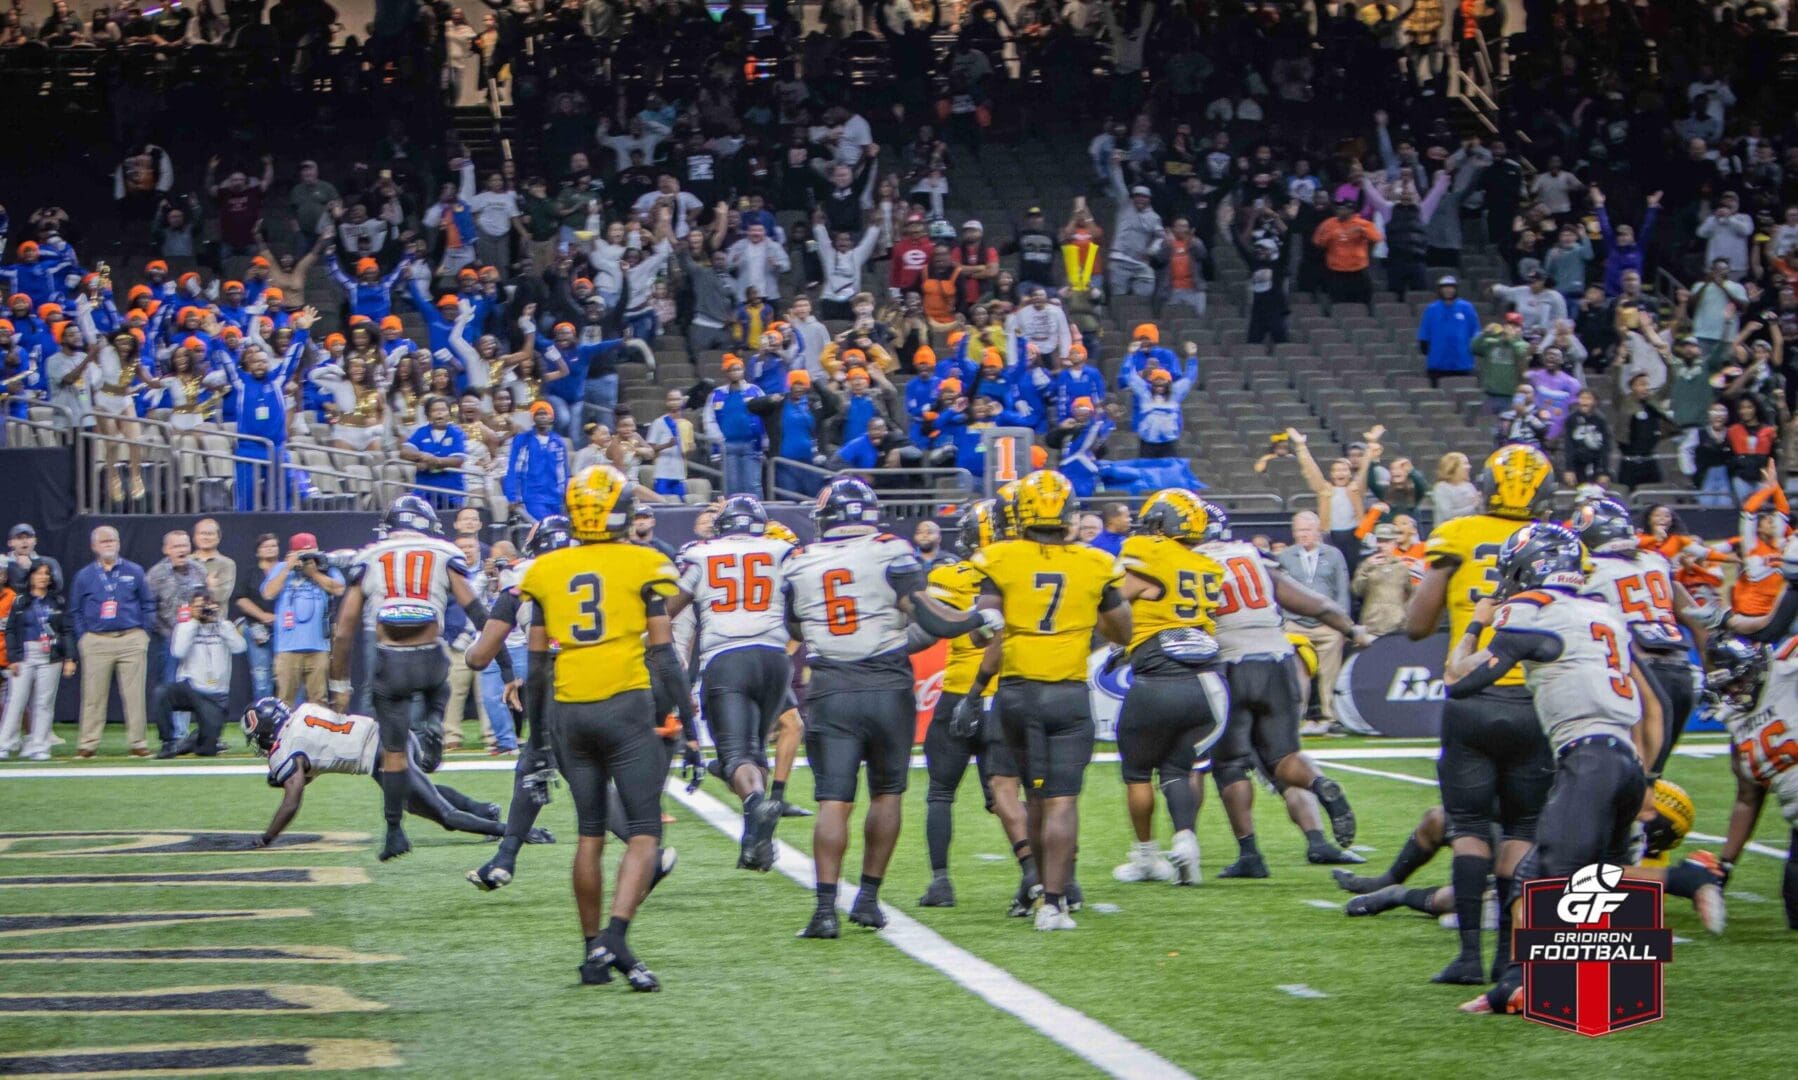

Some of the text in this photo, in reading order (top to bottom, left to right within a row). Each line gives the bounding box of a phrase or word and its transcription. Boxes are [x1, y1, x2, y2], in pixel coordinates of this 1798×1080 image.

[994, 437, 1018, 481] 1
[379, 550, 434, 601] 10
[707, 552, 774, 613] 56
[822, 568, 860, 637] 6
[1033, 571, 1067, 634] 7
[568, 572, 606, 645] 3
[1589, 621, 1634, 700] 3
[303, 714, 355, 735] 1
